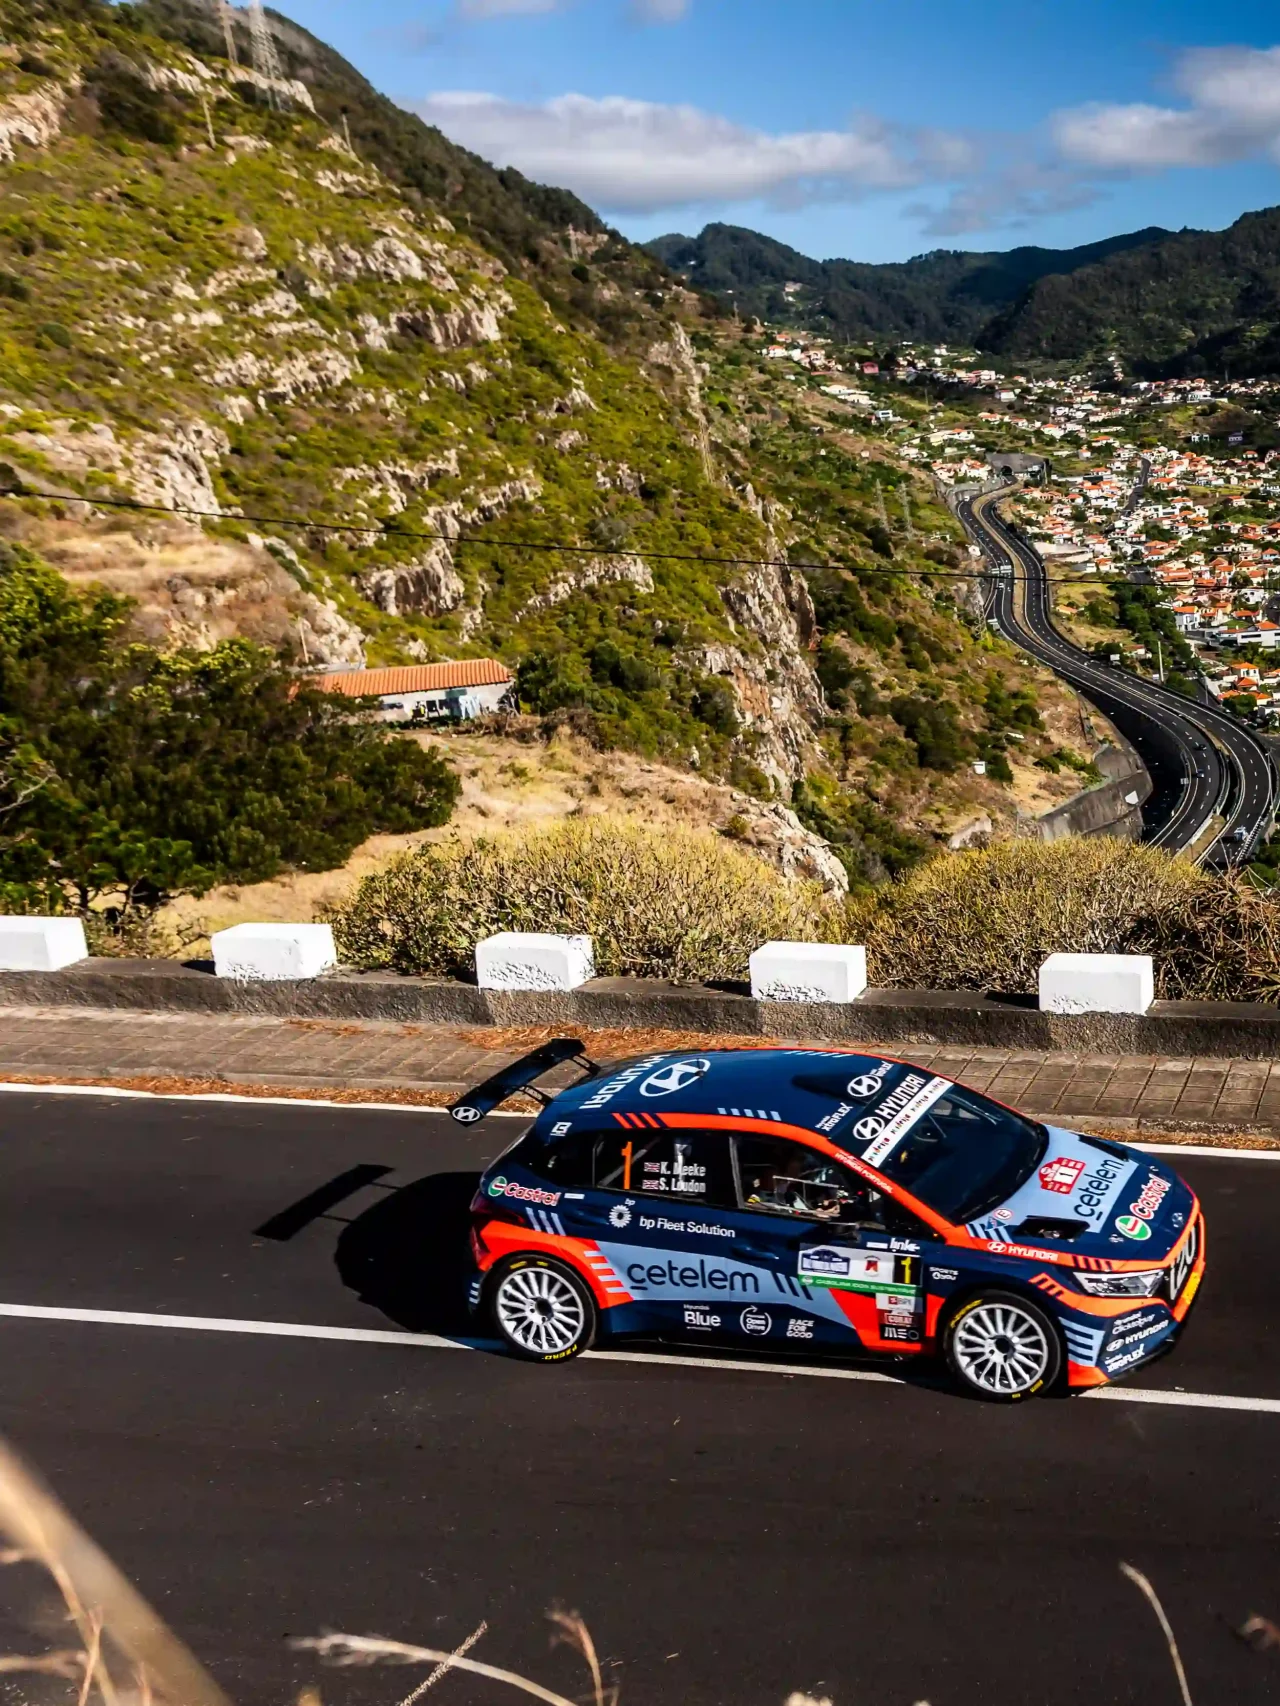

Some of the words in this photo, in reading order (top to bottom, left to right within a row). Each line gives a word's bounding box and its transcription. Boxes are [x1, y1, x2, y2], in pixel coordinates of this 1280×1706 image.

[579, 1054, 671, 1109] HYUNDAI
[874, 1073, 926, 1120] HYUNDAI
[621, 1141, 632, 1190] 1
[660, 1161, 671, 1175] K.
[504, 1182, 562, 1206] Castrol
[658, 1177, 669, 1191] S.
[1073, 1159, 1125, 1221] cetelem
[624, 1198, 636, 1206] bp
[1130, 1173, 1172, 1220] Castrol
[639, 1216, 656, 1230] bp
[656, 1217, 685, 1232] Fleet
[686, 1221, 736, 1238] Solution
[1008, 1245, 1059, 1261] HYUNDAI
[626, 1258, 760, 1293] cetelem
[900, 1255, 912, 1284] 1
[684, 1310, 722, 1327] Blue
[788, 1324, 808, 1332] FOR
[789, 1319, 815, 1327] RACE
[786, 1330, 814, 1339] GOOD
[1125, 1320, 1170, 1344] HYUNDAI
